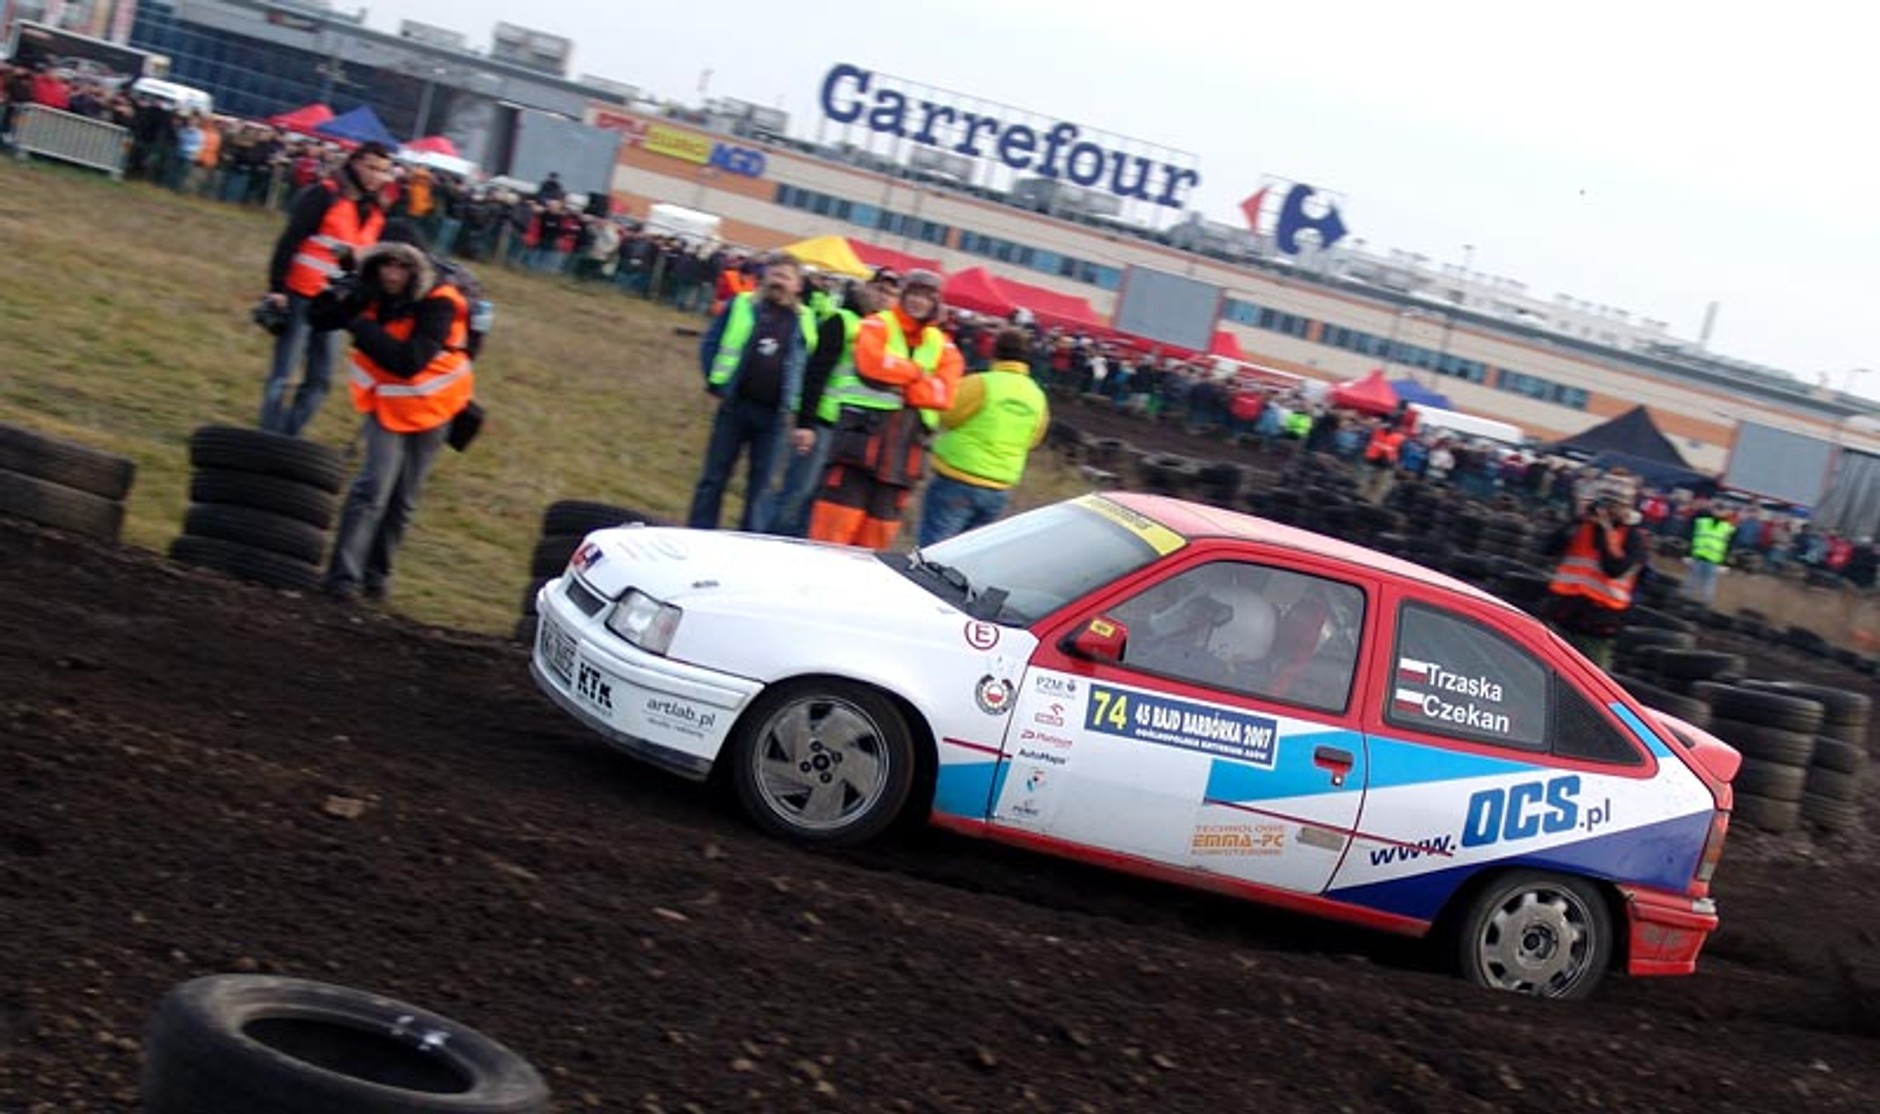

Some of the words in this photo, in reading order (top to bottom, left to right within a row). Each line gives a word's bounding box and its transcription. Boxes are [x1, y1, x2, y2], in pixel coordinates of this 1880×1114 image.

[821, 63, 1199, 208] Carrefour
[976, 622, 990, 643] E
[1427, 662, 1503, 702] Trzaska
[646, 698, 716, 728] artlab.pl
[1093, 690, 1129, 731] 74
[1135, 702, 1151, 726] 45
[1152, 706, 1181, 732] RAJD
[1244, 723, 1273, 749] 2007
[1422, 695, 1510, 733] Czekan
[1191, 834, 1285, 848] EMMA-PC
